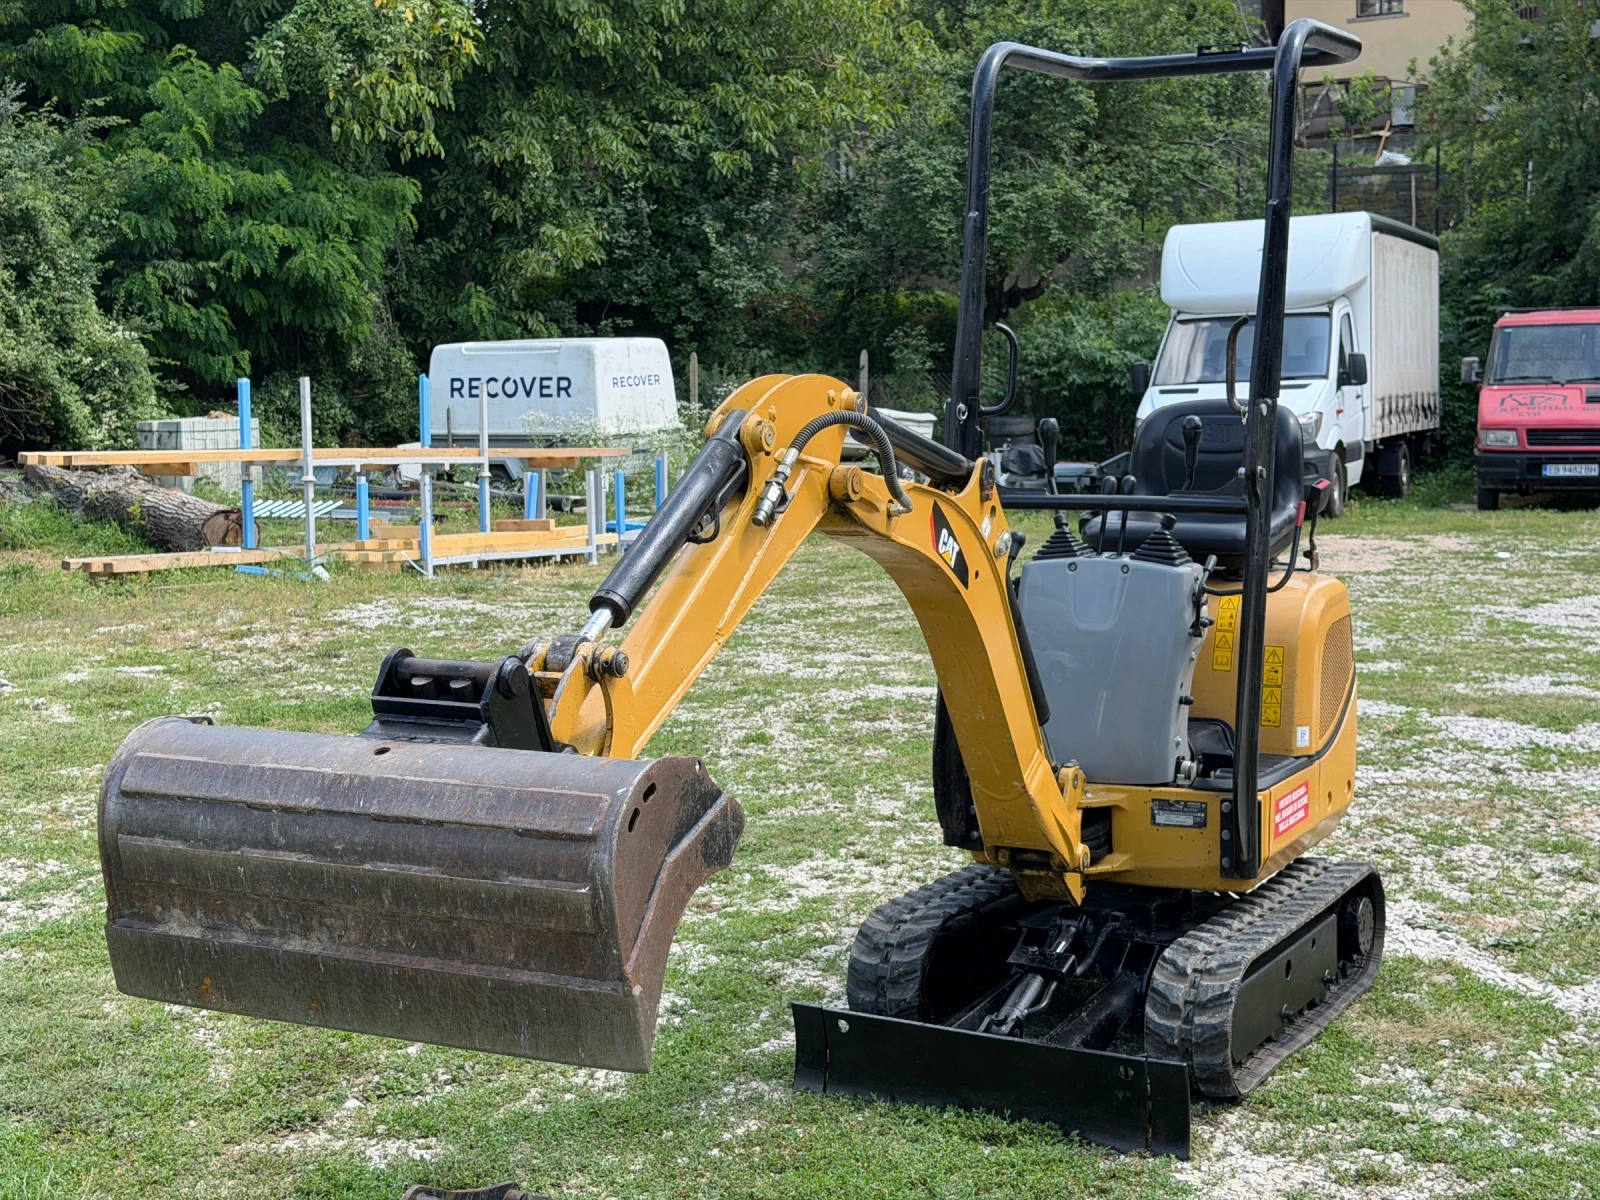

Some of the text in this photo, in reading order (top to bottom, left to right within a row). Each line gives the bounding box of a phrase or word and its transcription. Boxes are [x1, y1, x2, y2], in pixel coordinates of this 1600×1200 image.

[450, 376, 573, 399] RECOVER
[612, 374, 660, 389] RECOVER
[938, 527, 960, 569] CAT
